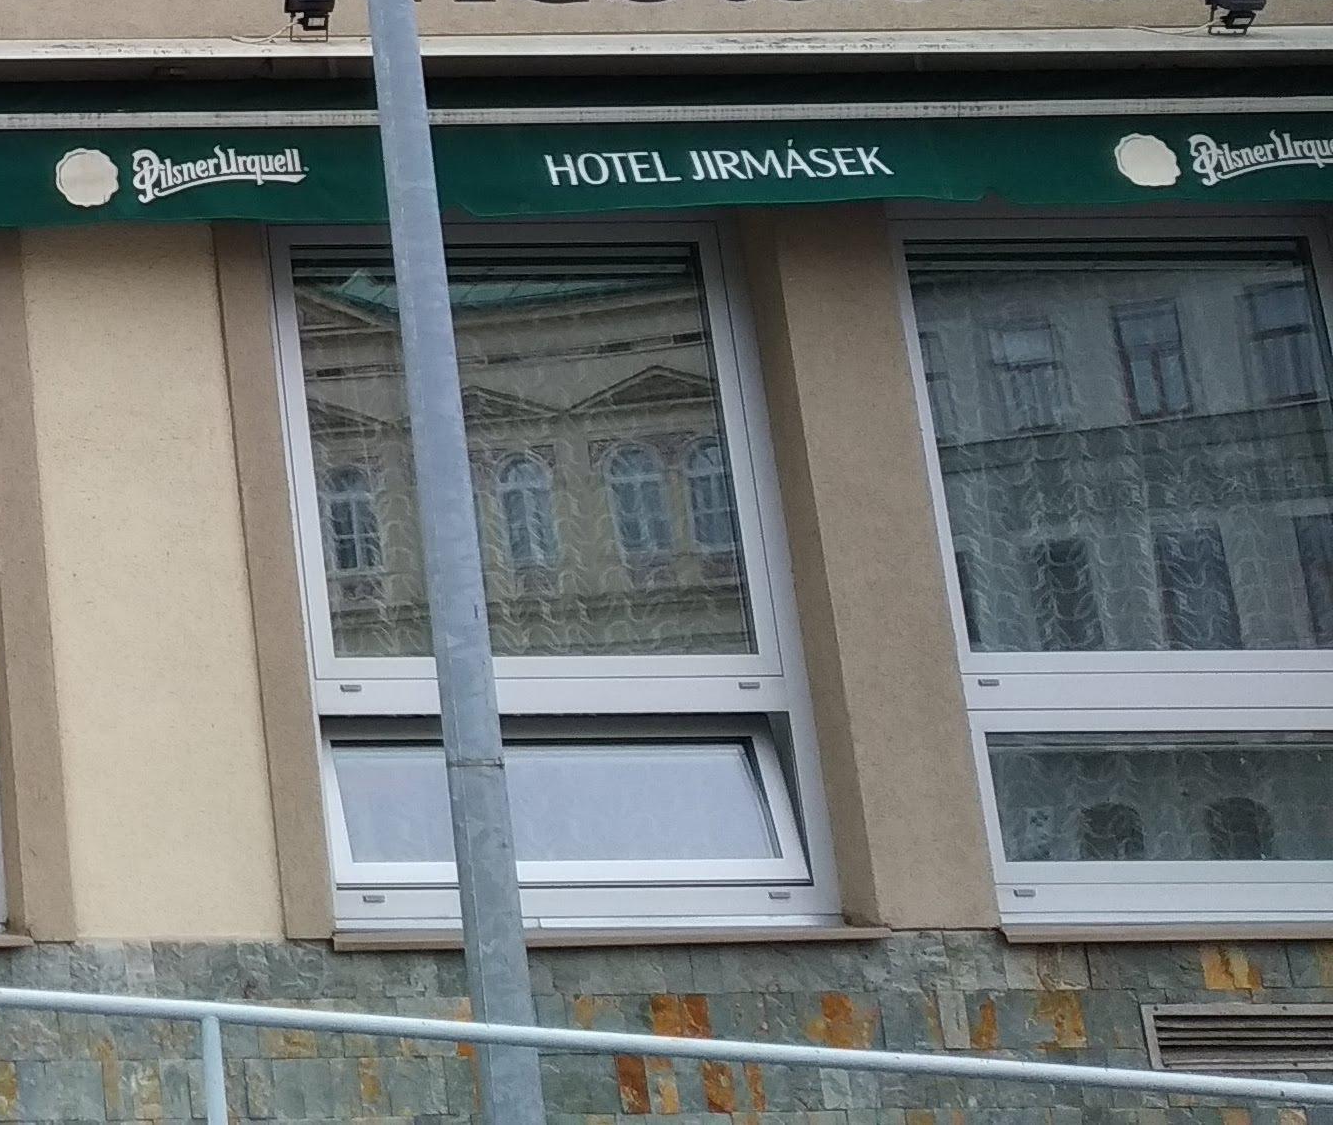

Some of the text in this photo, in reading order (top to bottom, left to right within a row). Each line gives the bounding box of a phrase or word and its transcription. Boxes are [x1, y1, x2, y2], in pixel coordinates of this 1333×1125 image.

[132, 145, 301, 203] Pilsner Urquell
[544, 139, 894, 186] HOTEL JIRMÁSEK
[1188, 129, 1333, 186] Pilsner Urqu
